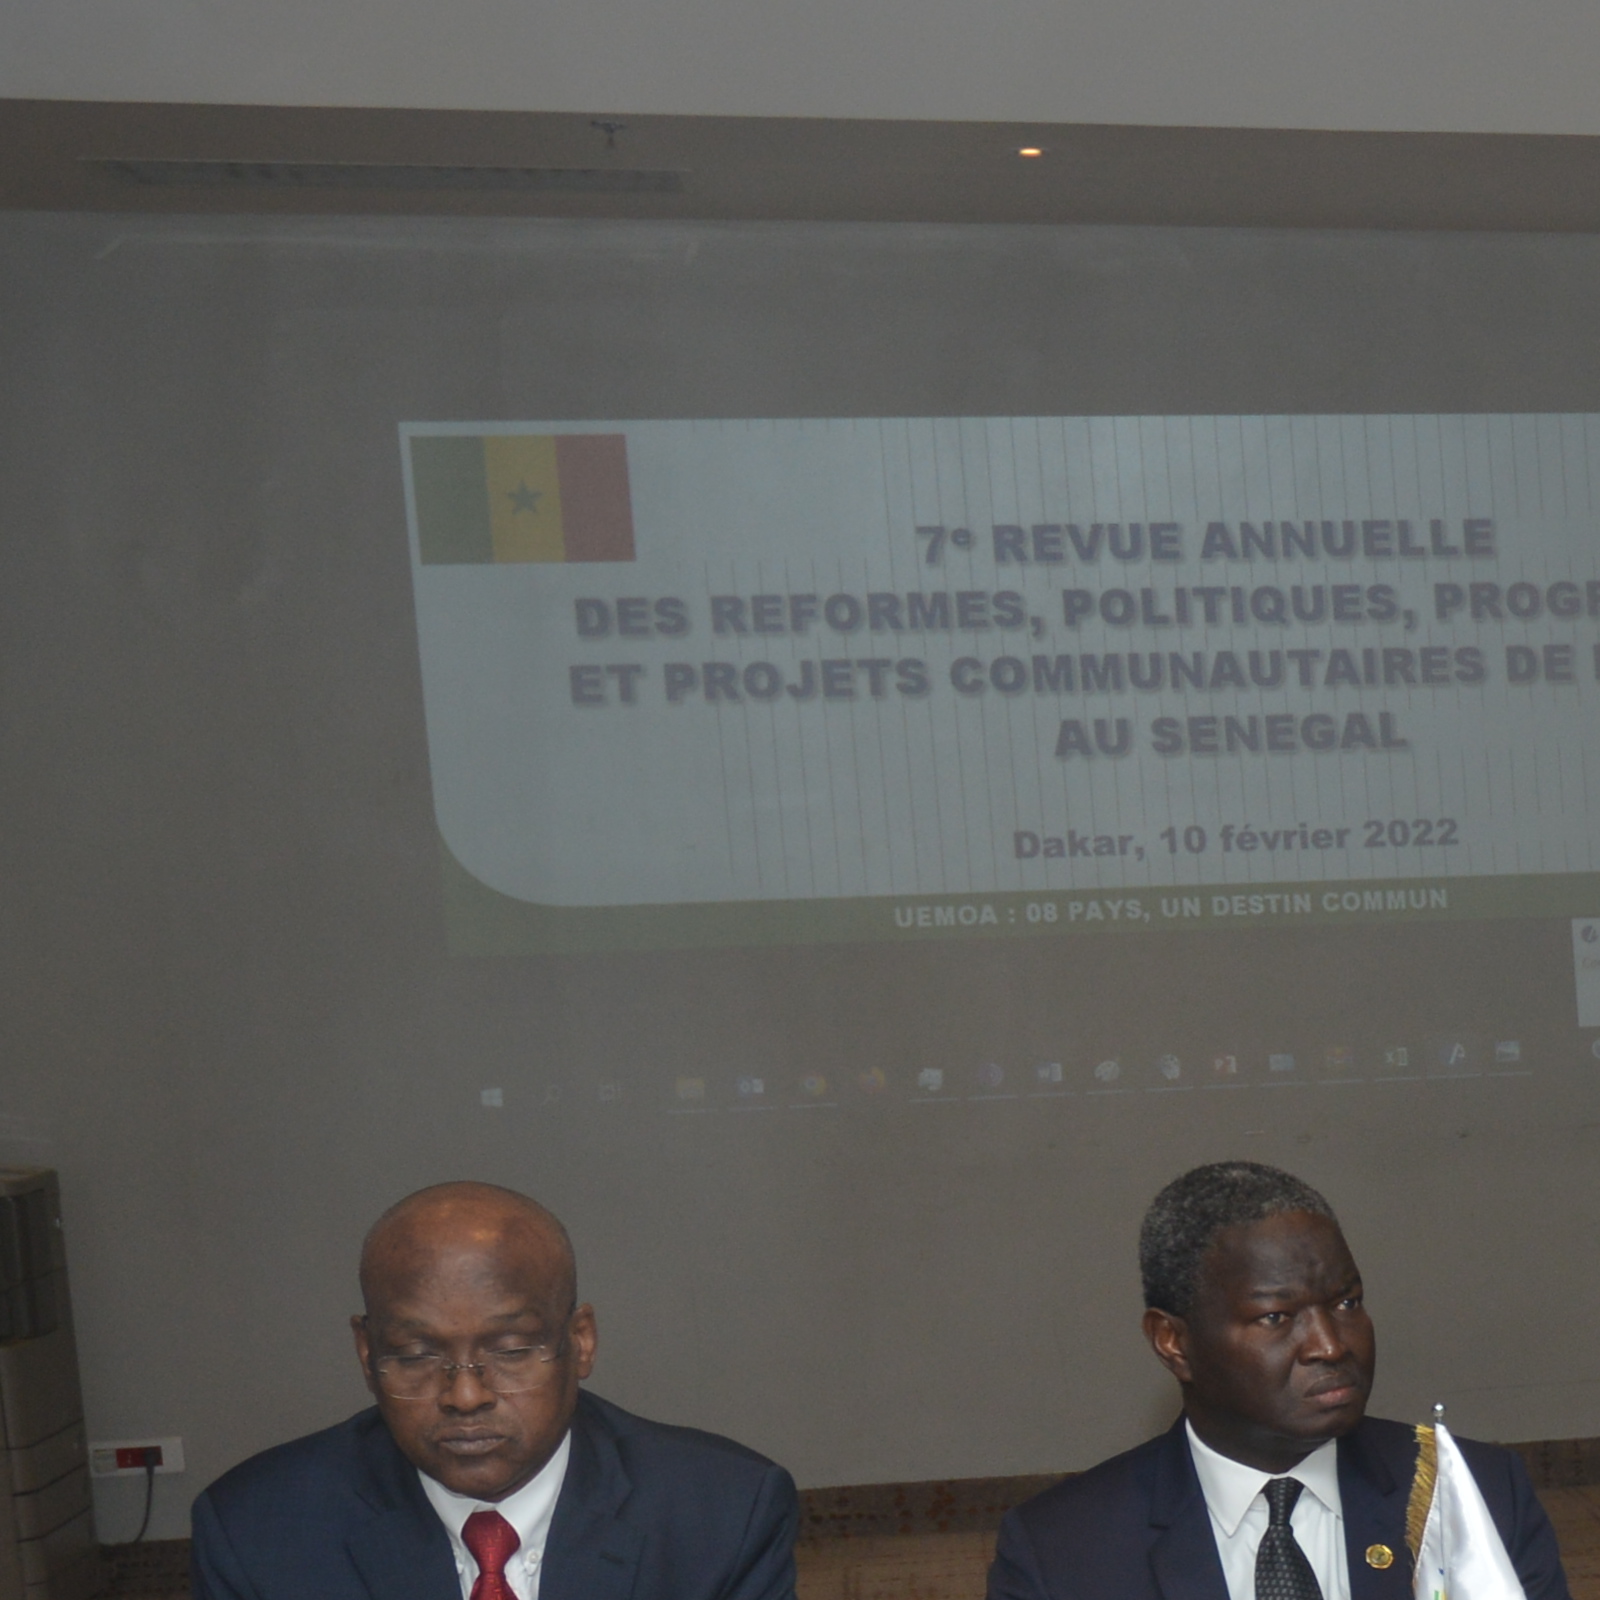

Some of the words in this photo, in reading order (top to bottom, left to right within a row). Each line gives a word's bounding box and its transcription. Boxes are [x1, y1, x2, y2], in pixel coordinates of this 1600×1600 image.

[992, 523, 1182, 563] REVUE
[1201, 518, 1495, 561] ANNUELLE
[574, 596, 690, 638] DES
[711, 590, 1044, 637] REFORMES,
[1062, 584, 1415, 630] POLITIQUES,
[568, 663, 642, 704] ET
[663, 657, 930, 703] PROJETS
[950, 646, 1486, 696] COMMUNAUTAIRES
[1506, 644, 1574, 684] DE
[1055, 718, 1130, 758] AU
[1151, 712, 1408, 754] SENEGAL
[1013, 829, 1146, 862] Dakar,
[1160, 826, 1206, 855] 10
[1220, 822, 1351, 853] février
[1363, 818, 1460, 849] 2022
[895, 902, 998, 928] UEMOA
[1025, 901, 1058, 924] 08
[1068, 898, 1151, 924] PAYS,
[1161, 896, 1201, 918] UN
[1213, 893, 1312, 918] DESTIN
[1322, 887, 1449, 913] COMMUN
